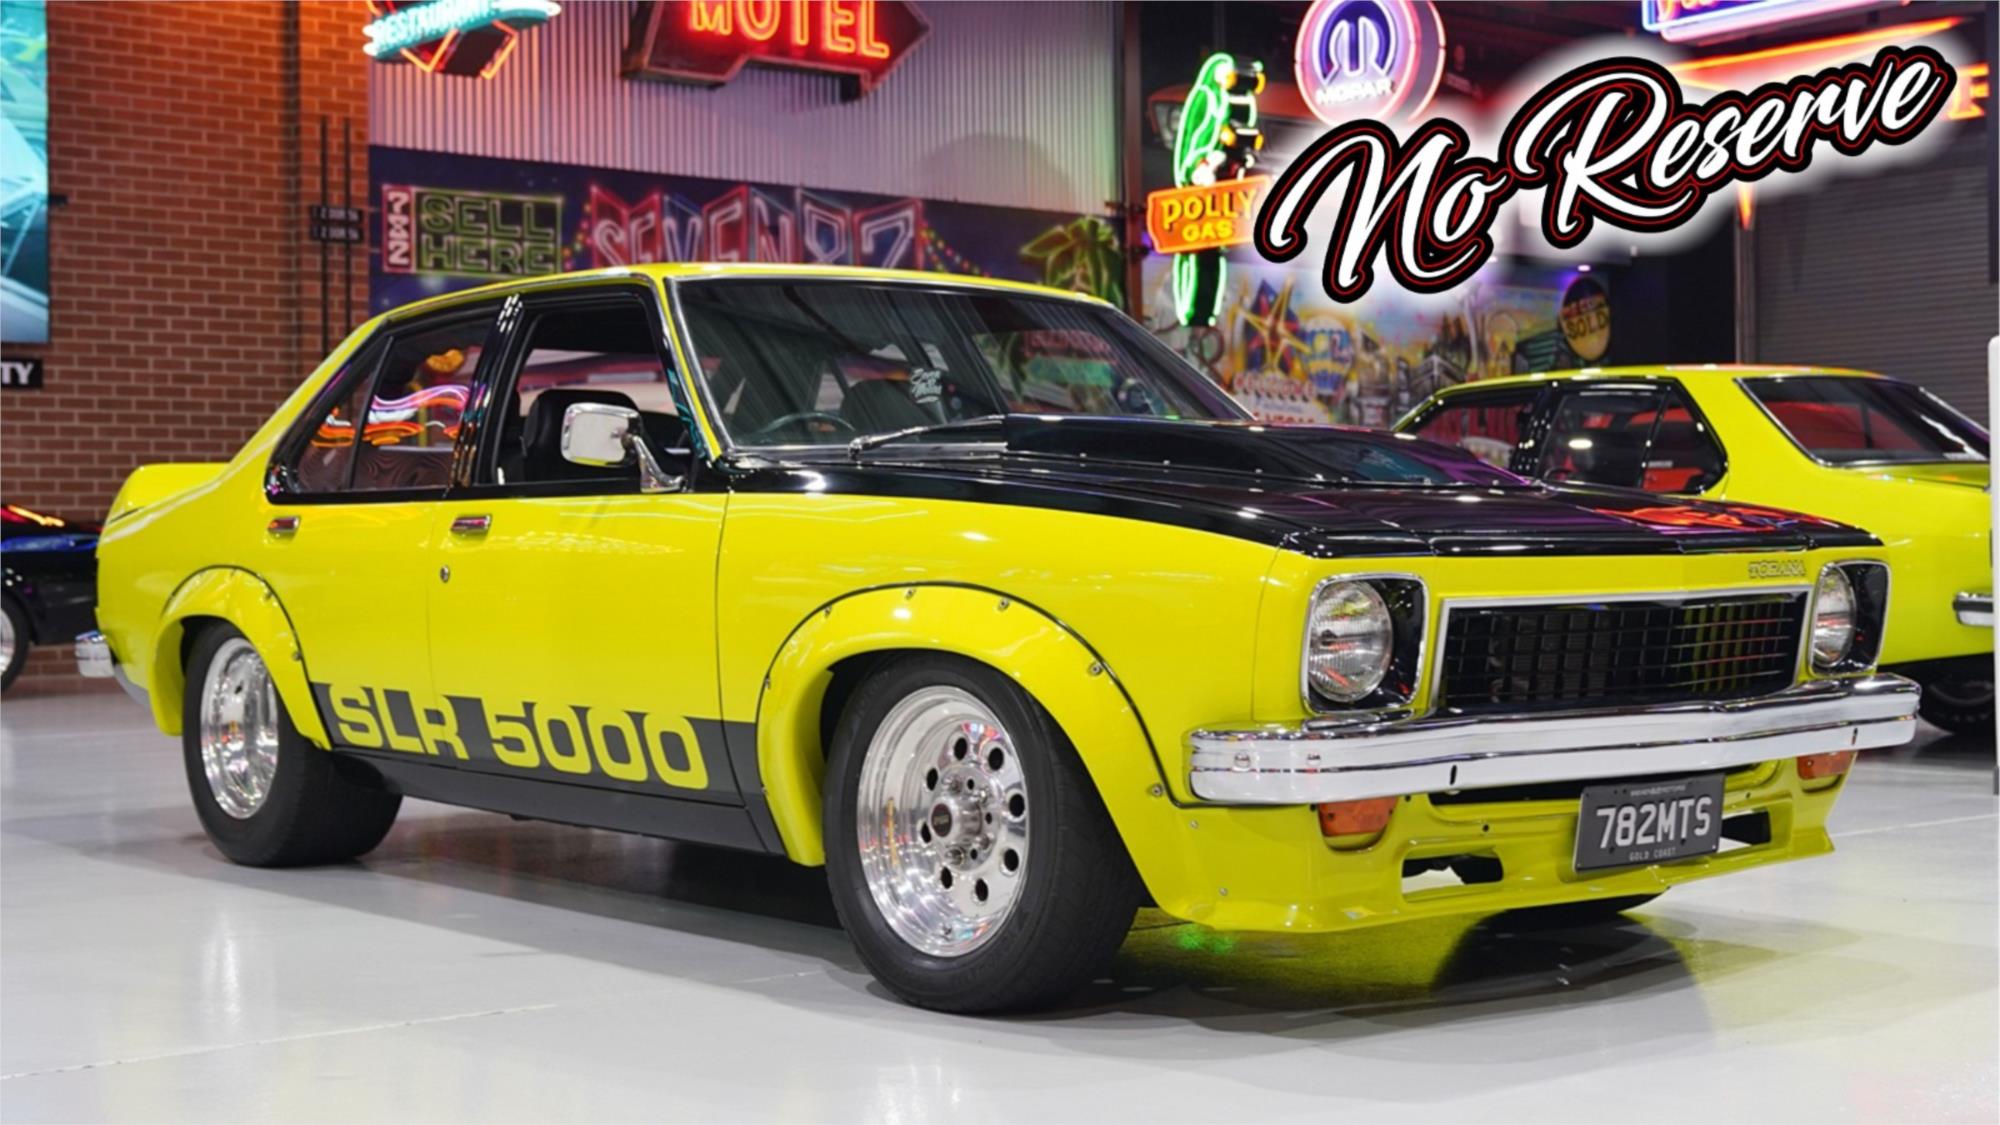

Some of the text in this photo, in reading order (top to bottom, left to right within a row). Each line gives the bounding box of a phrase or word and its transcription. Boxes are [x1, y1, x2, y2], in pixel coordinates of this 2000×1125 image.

[690, 0, 889, 59] MOTEL
[1316, 77, 1396, 105] MOPAR
[421, 194, 555, 241] SELL
[1162, 188, 1257, 230] POLLY
[1182, 220, 1233, 242] GAS
[421, 233, 555, 275] HERE
[1566, 309, 1607, 340] SOLD
[1748, 560, 1806, 579] TORANA
[329, 684, 709, 790] SLR 5000
[1596, 796, 1713, 849] 782MTS
[1629, 846, 1677, 862] GOLD COAST
